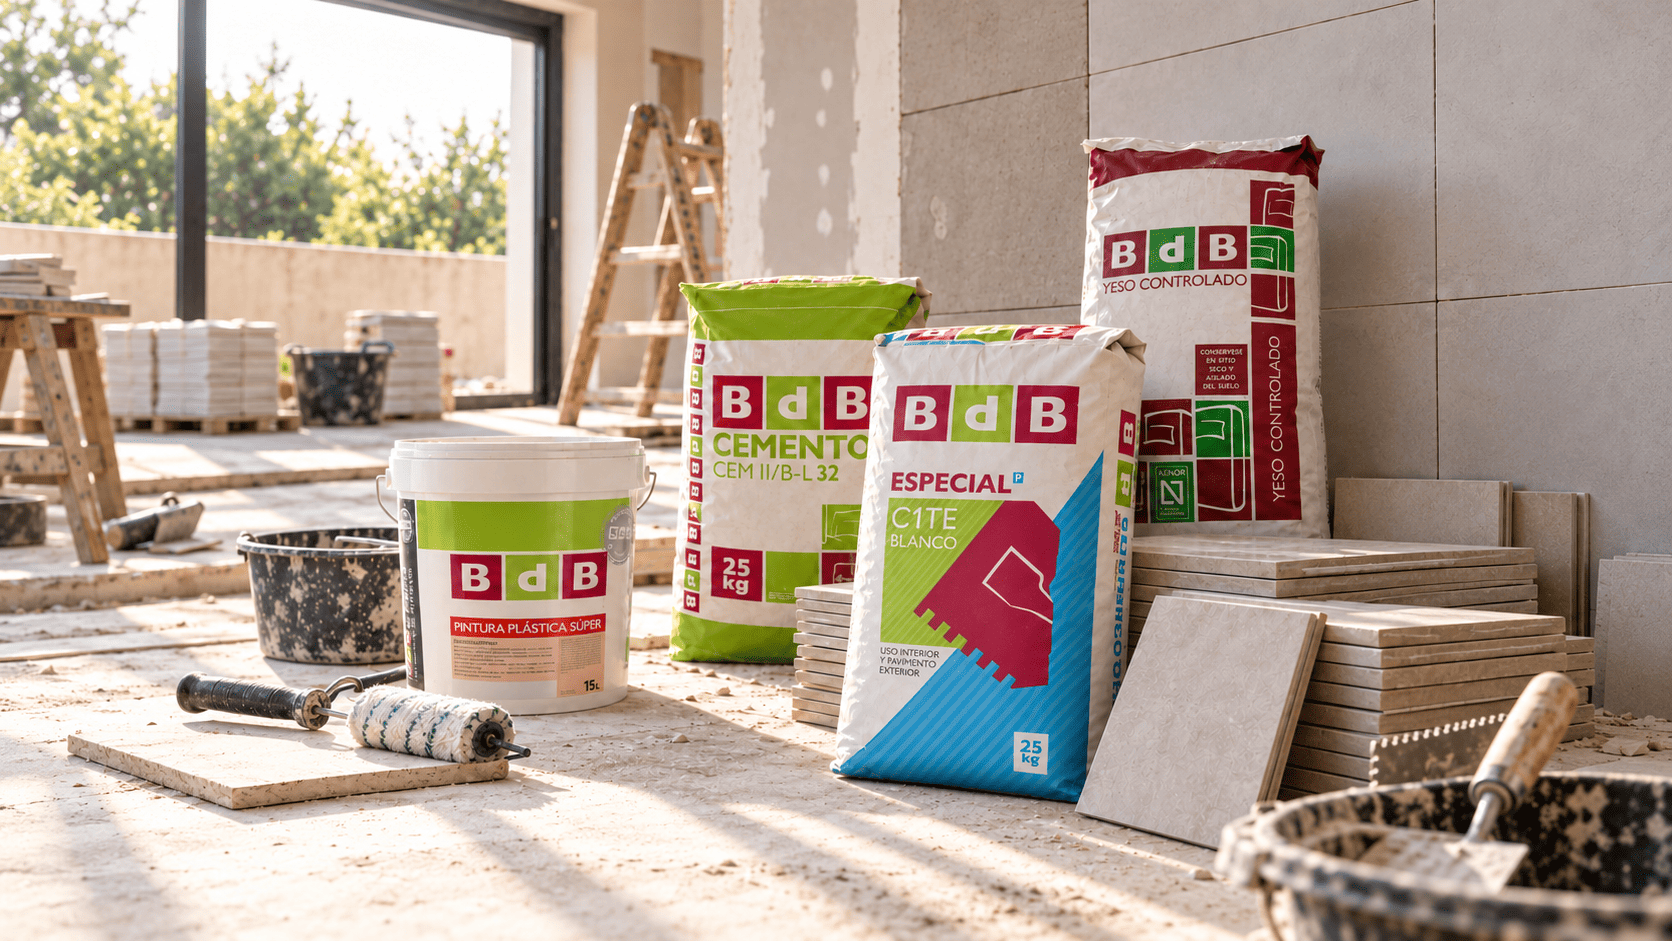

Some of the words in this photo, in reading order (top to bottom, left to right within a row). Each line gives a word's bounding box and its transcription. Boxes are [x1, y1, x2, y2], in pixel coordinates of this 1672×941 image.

[1103, 278, 1135, 294] YESO
[1139, 274, 1247, 290] CONTROLADO
[1268, 335, 1283, 452] CONTROLADO
[713, 432, 868, 460] CEMENTO
[713, 461, 753, 479] CEM
[760, 463, 812, 482] II/B-L
[816, 464, 839, 482] 32
[1271, 459, 1285, 502] YESO
[891, 472, 1012, 494] ESPECIAL
[891, 506, 958, 530] C1TE
[890, 533, 957, 550] BLANCO
[722, 556, 750, 577] 25
[722, 575, 749, 595] kg
[454, 622, 505, 634] PINTURA
[507, 621, 566, 634] PLÁSTICA
[570, 618, 602, 631] SÚPER
[880, 647, 898, 655] USO
[900, 648, 940, 658] INTERIOR
[880, 656, 885, 664] Y
[887, 657, 937, 668] PAVIMENTO
[879, 666, 920, 677] EXTERIOR
[1020, 739, 1043, 755] 25
[1021, 754, 1040, 767] kg
